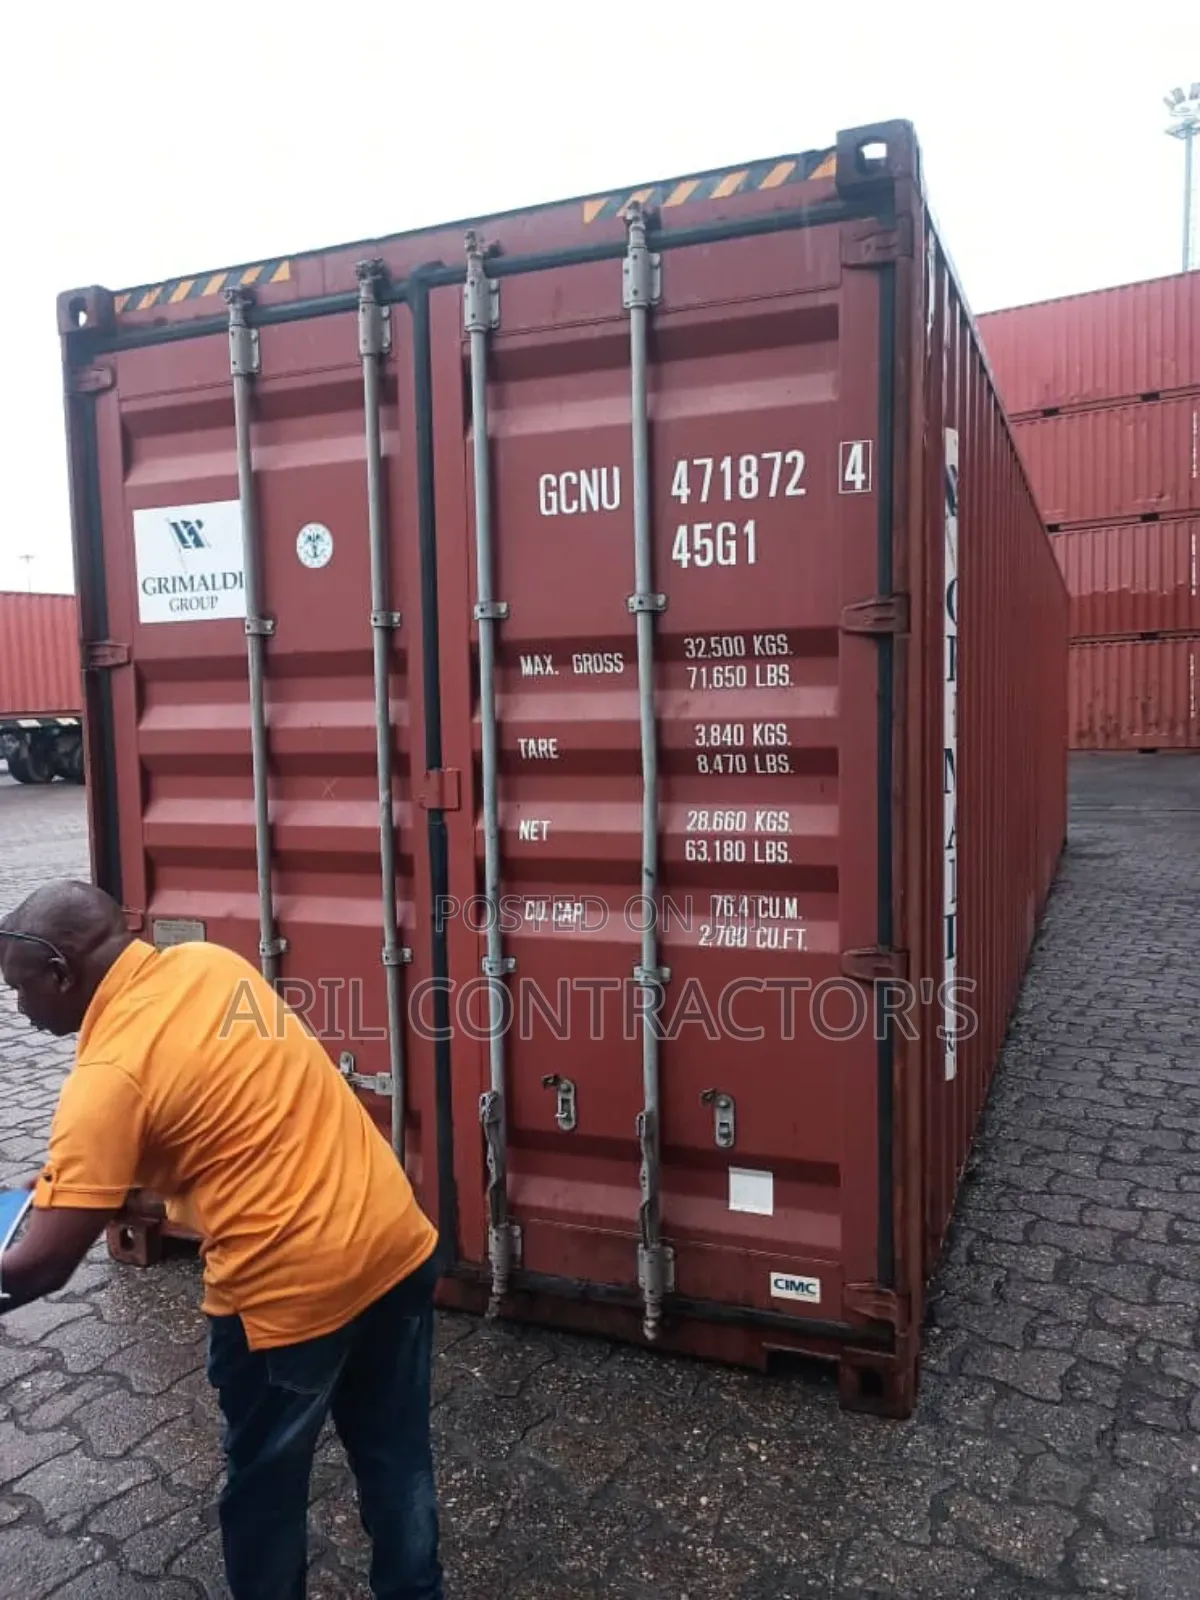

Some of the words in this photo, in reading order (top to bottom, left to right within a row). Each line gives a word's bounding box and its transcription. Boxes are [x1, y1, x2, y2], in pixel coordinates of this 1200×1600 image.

[539, 466, 621, 516] GCNU
[671, 451, 806, 504] 471872
[845, 443, 866, 490] 4
[671, 520, 757, 568] 45G1
[169, 595, 219, 612] GROUP
[753, 634, 793, 656] KGS.
[520, 655, 560, 677] MAX.
[572, 653, 624, 675] GROSS
[686, 665, 747, 690] 71,650
[755, 664, 795, 687] LBS.
[694, 724, 745, 747] 3,840
[752, 723, 792, 747] KGS.
[518, 738, 559, 760] TARE
[754, 754, 795, 775] LBS.
[518, 820, 551, 842] NET
[754, 811, 793, 833] KGS.
[753, 840, 793, 863] LBS.
[773, 1278, 817, 1296] CIMC
